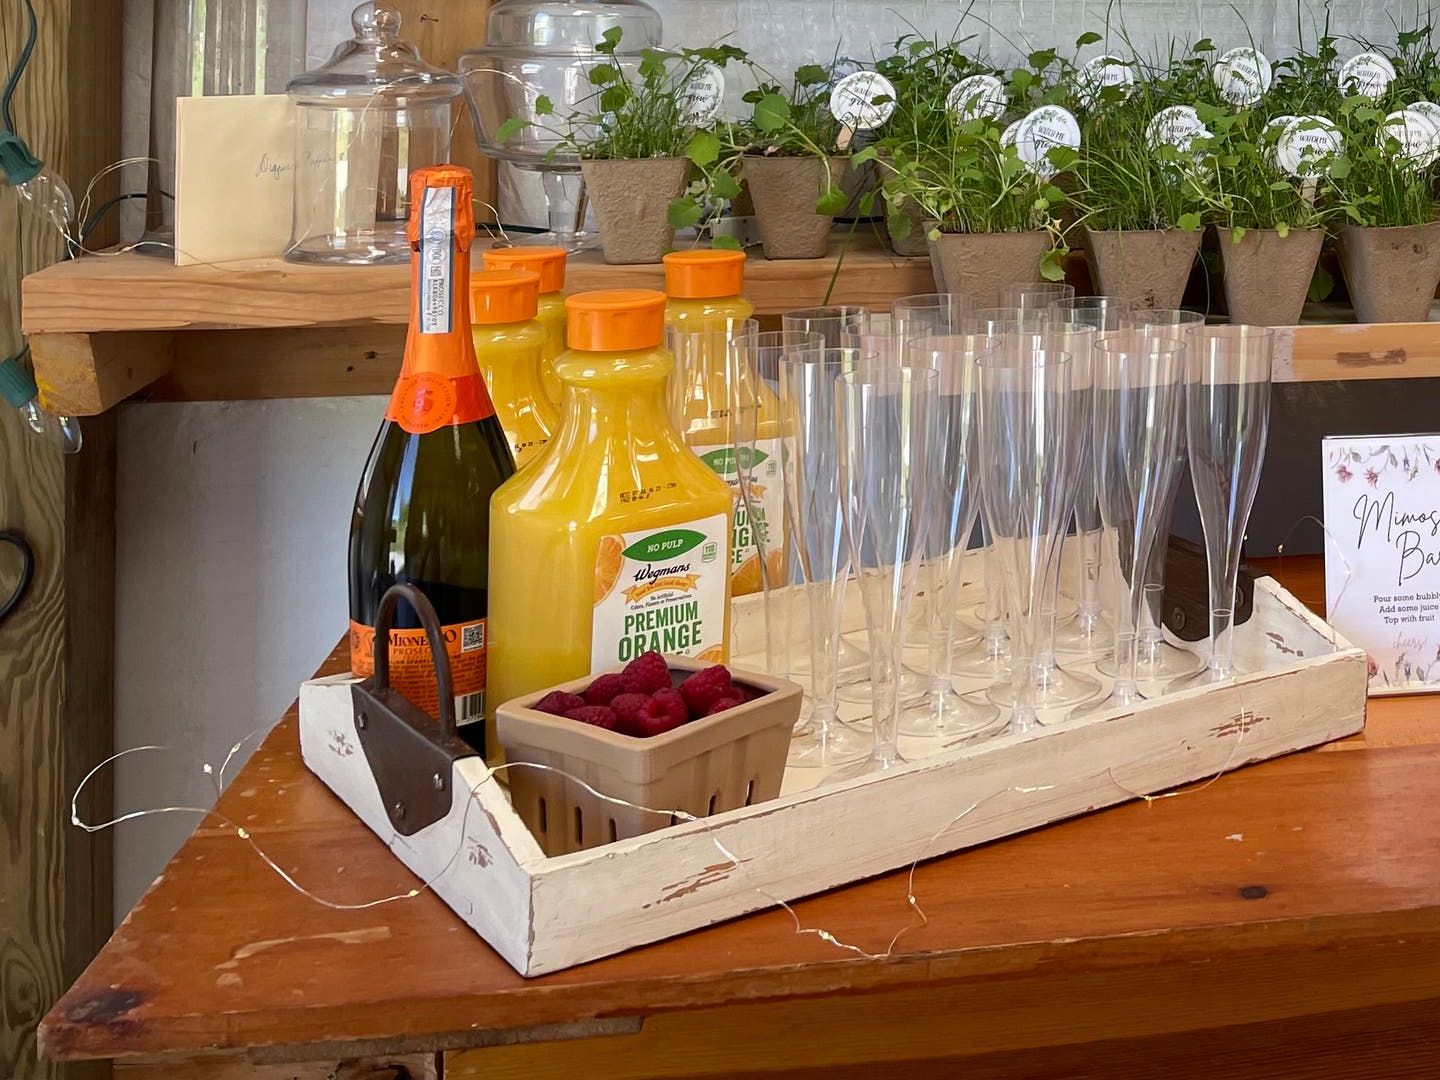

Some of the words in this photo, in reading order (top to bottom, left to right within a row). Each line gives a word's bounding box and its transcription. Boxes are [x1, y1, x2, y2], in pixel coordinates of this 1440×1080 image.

[1236, 62, 1252, 74] WATCH
[1252, 70, 1259, 79] ME
[688, 94, 707, 103] grow
[1038, 125, 1055, 137] WATCH
[1055, 131, 1065, 141] ME
[1299, 135, 1318, 144] WATCH
[1318, 137, 1328, 145] ME
[647, 544, 660, 553] NO
[662, 539, 684, 551] PULP
[633, 563, 691, 585] Wegmans
[1373, 595, 1392, 603] Pour
[1393, 594, 1415, 602] some
[1379, 605, 1396, 614] Add
[1397, 605, 1419, 613] some
[1420, 603, 1439, 613] juice
[624, 600, 699, 635] PREMIUM
[1384, 616, 1399, 625] Top
[1400, 614, 1417, 623] with
[1418, 614, 1436, 622] fruit
[618, 620, 703, 662] ORANGE
